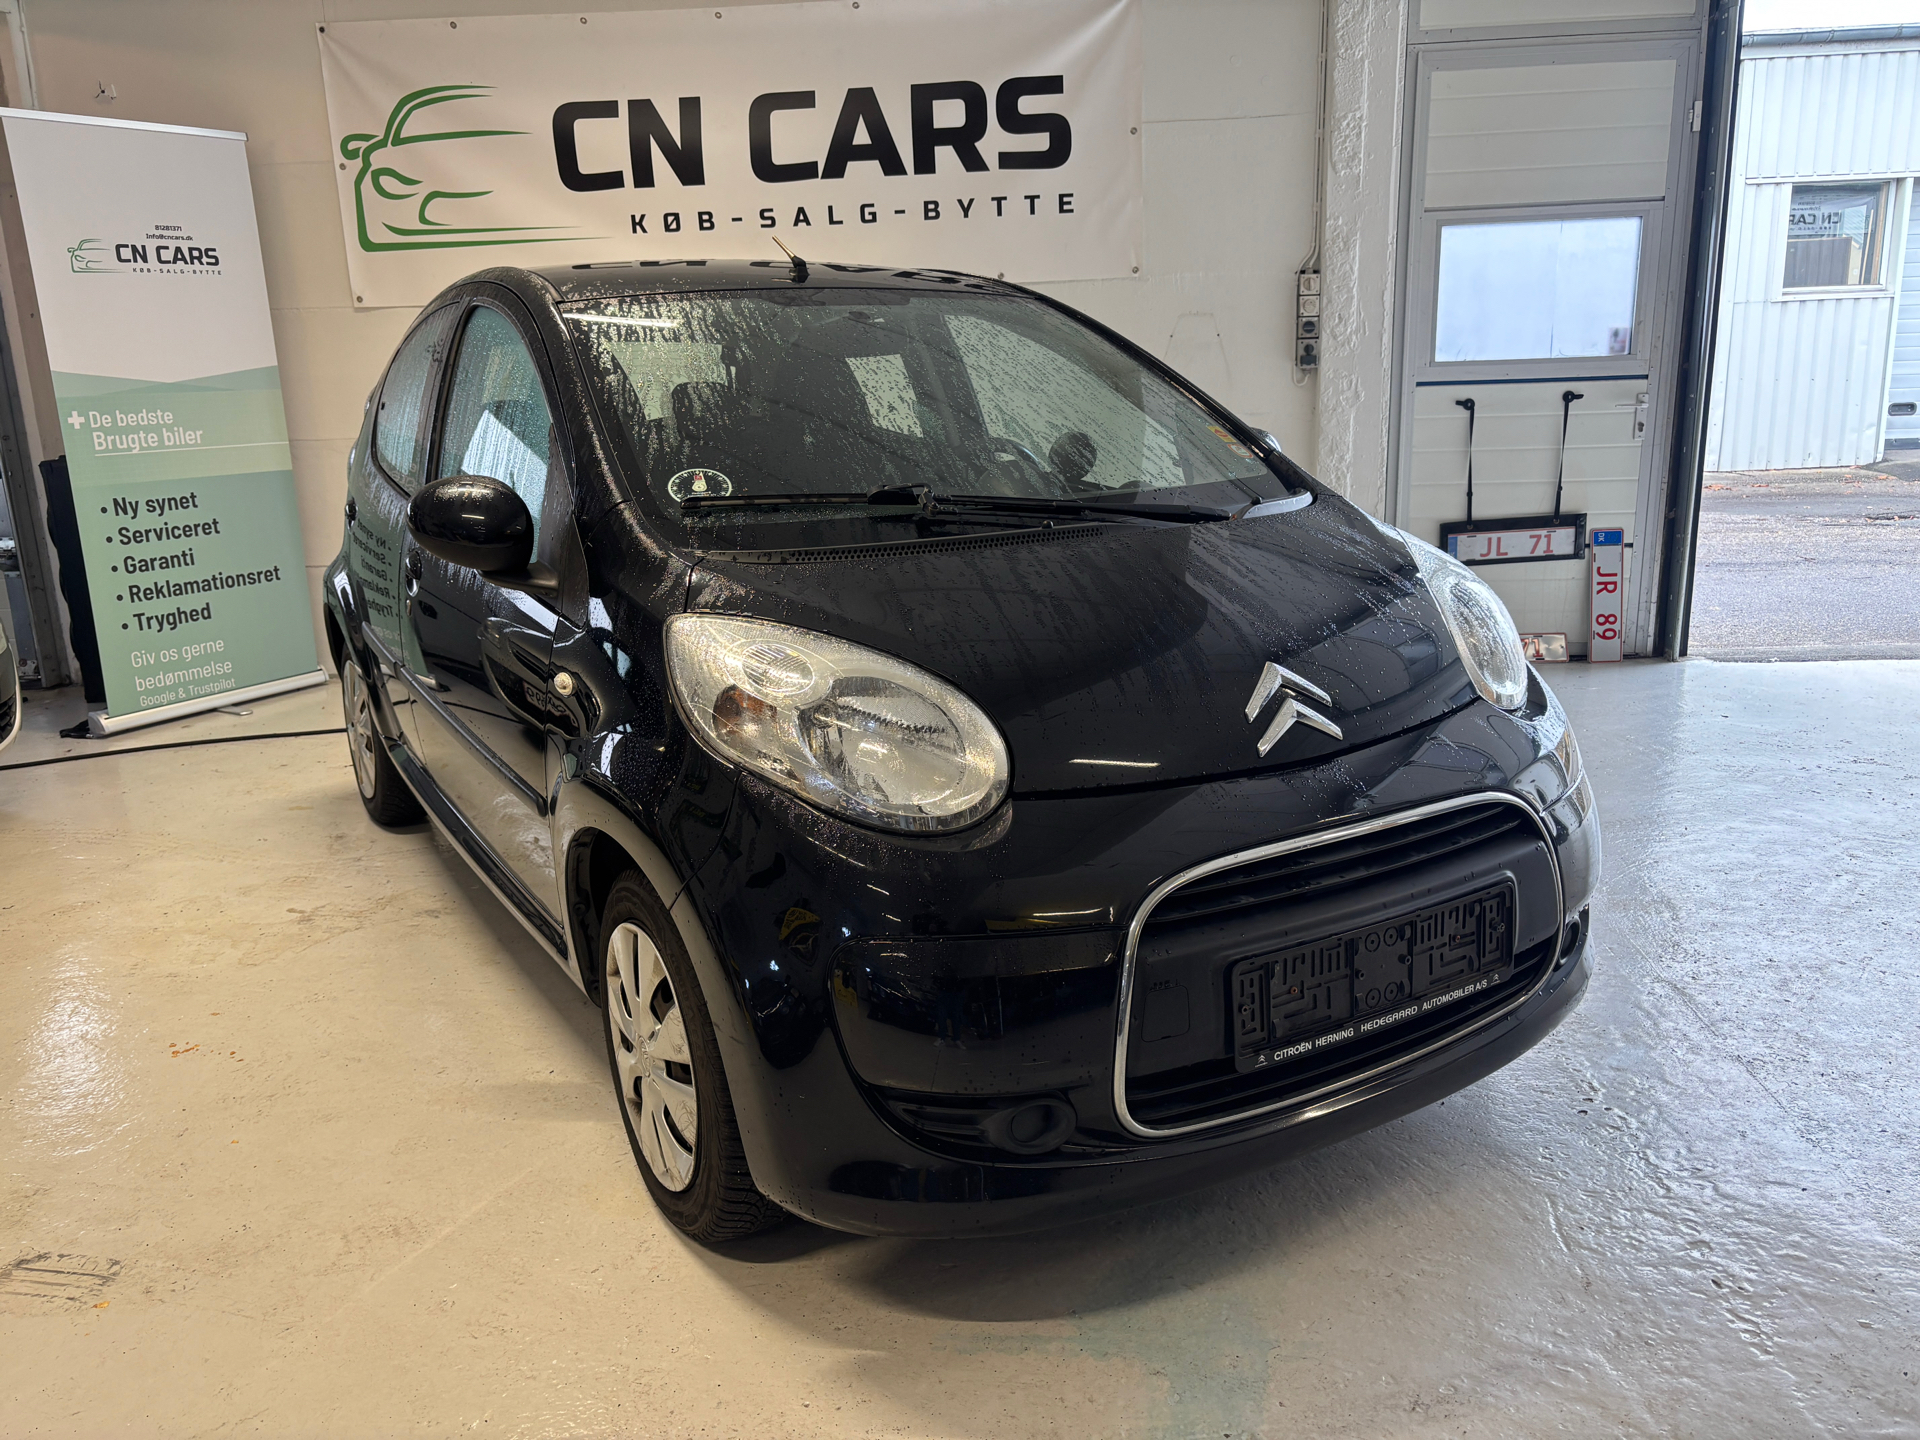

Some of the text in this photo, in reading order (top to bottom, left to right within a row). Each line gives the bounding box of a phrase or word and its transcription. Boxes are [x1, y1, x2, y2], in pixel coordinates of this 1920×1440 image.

[552, 75, 1072, 192] CN CARS
[631, 193, 1074, 234] KØB-SALG-BYTTE
[154, 224, 182, 232] 81281371
[115, 243, 220, 267] CN CARS
[89, 409, 174, 428] De bedste
[92, 427, 203, 452] Brugte biler
[113, 492, 198, 520] Ny synet
[117, 518, 221, 546] Serviceret
[1480, 534, 1554, 557] JL 71
[1597, 532, 1605, 542] DK
[123, 548, 195, 575] Garanti
[128, 565, 281, 603] Reklamationsret
[1596, 566, 1618, 640] JR 89
[133, 602, 212, 633] Tryghed
[131, 640, 224, 668] Giv os gerne
[135, 661, 232, 691] bedømmelse
[140, 678, 236, 707] Google & Trustpilot
[1273, 979, 1488, 1060] CITROËN HERNING HEDEGAARD AUTOMOBILER A/S
